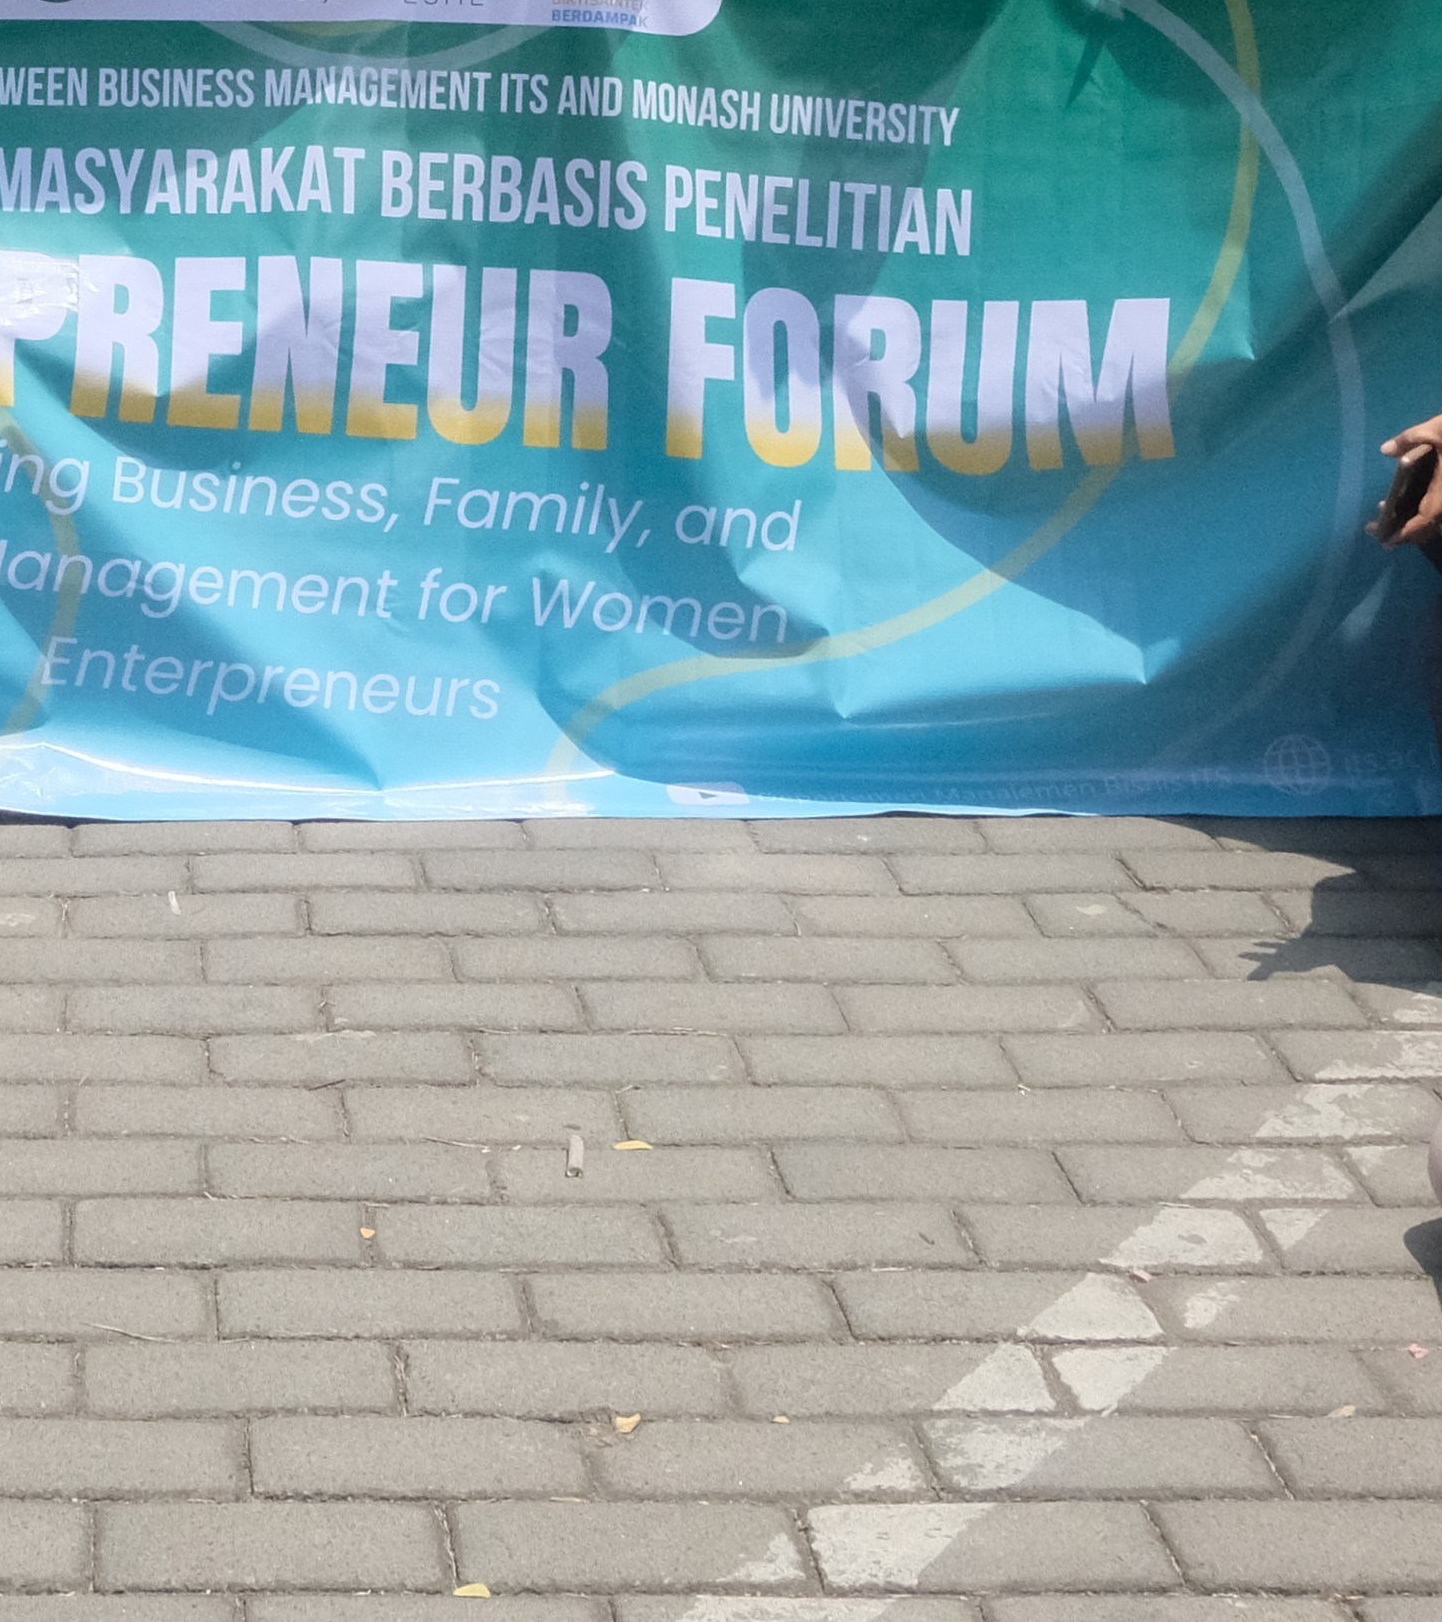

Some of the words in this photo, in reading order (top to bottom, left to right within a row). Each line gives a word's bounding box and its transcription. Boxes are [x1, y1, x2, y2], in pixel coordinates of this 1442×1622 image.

[551, 8, 648, 28] BERDAMPAK
[98, 67, 255, 108] BUSINESS
[264, 66, 492, 112] MANAGEMENT
[500, 72, 549, 115] ITS
[557, 75, 623, 117] AND
[632, 78, 761, 131] MONASH
[769, 92, 961, 147] UNIVERSITY
[380, 149, 648, 231] BERBASIS
[664, 163, 973, 257] PENELITIAN
[665, 275, 1176, 476] FORUM
[112, 455, 400, 533] Business,
[422, 476, 652, 554] Family,
[674, 499, 803, 552] and
[417, 567, 508, 625] for
[531, 576, 789, 644] Women
[39, 635, 502, 720] Enterpreneurs
